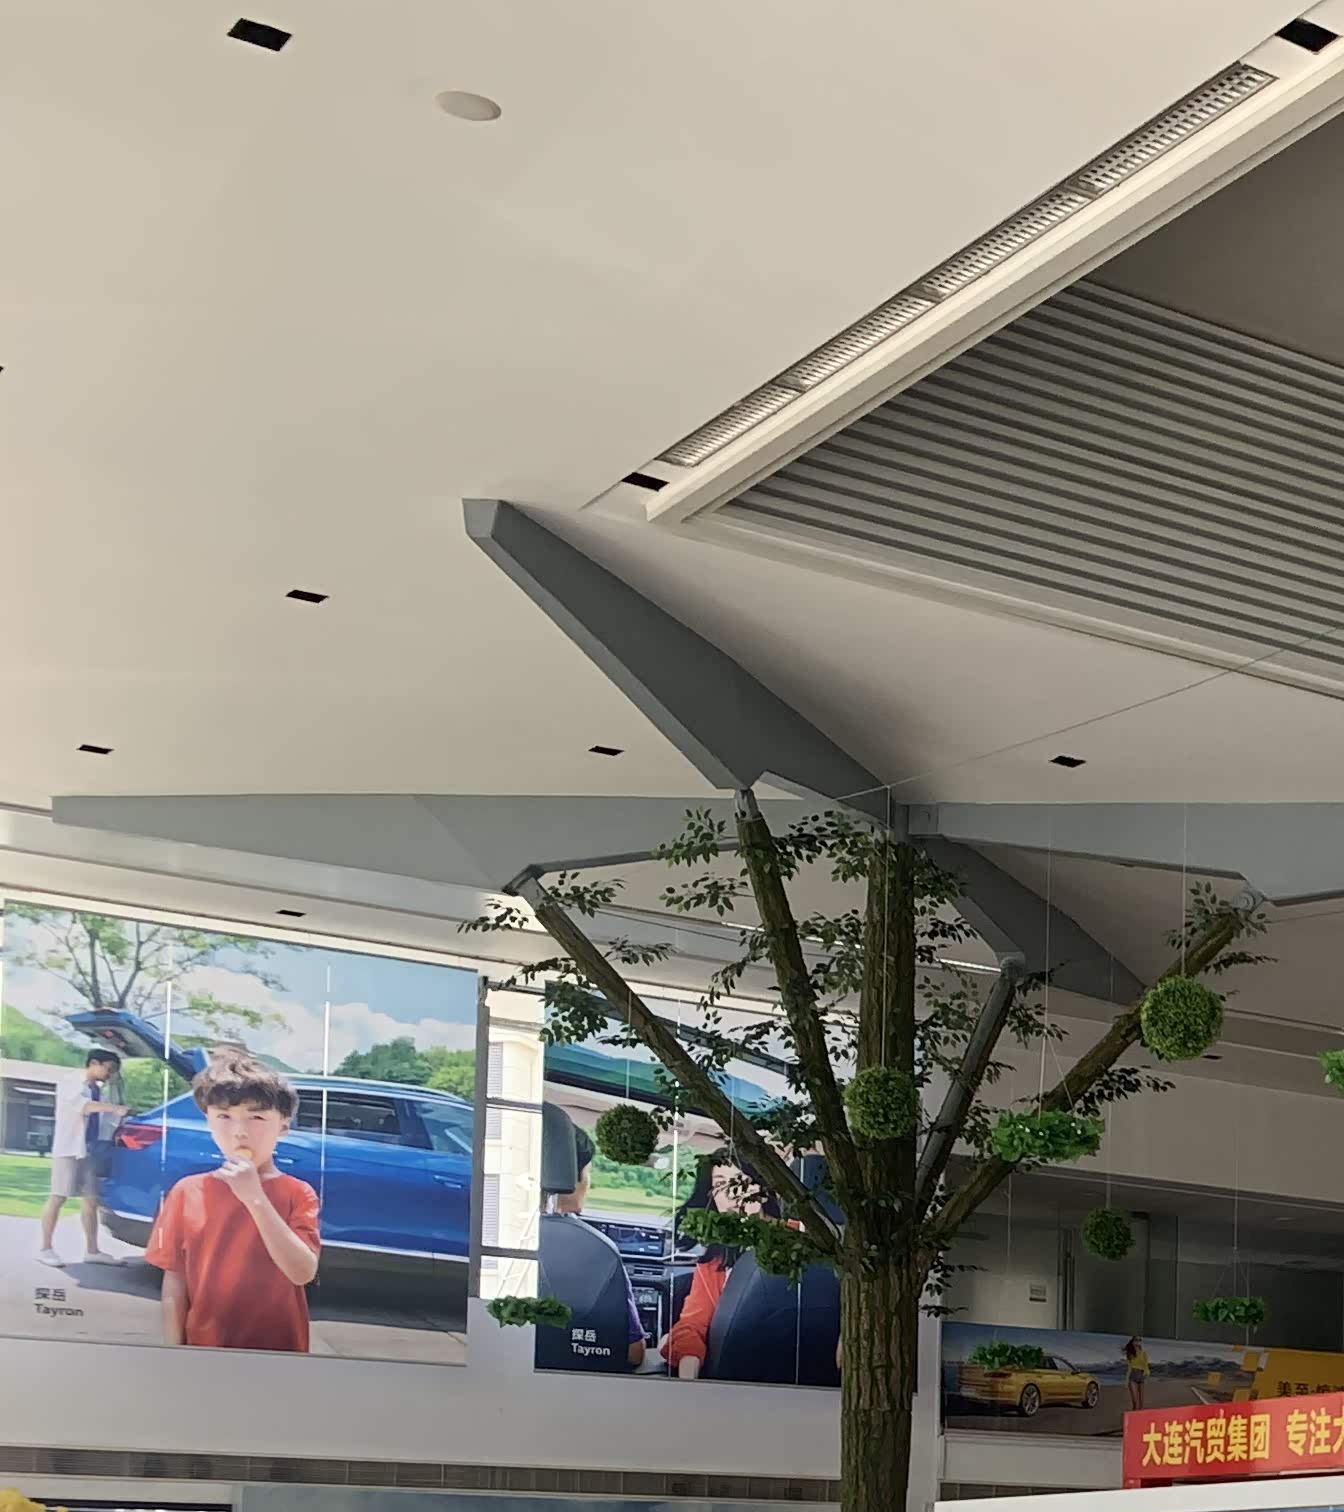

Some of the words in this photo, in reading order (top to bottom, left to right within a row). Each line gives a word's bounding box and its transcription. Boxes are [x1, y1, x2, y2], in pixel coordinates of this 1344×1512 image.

[35, 1303, 84, 1319] Tayron
[571, 1343, 611, 1359] Tayron
[1141, 1413, 1271, 1467] 大连汽贸集团
